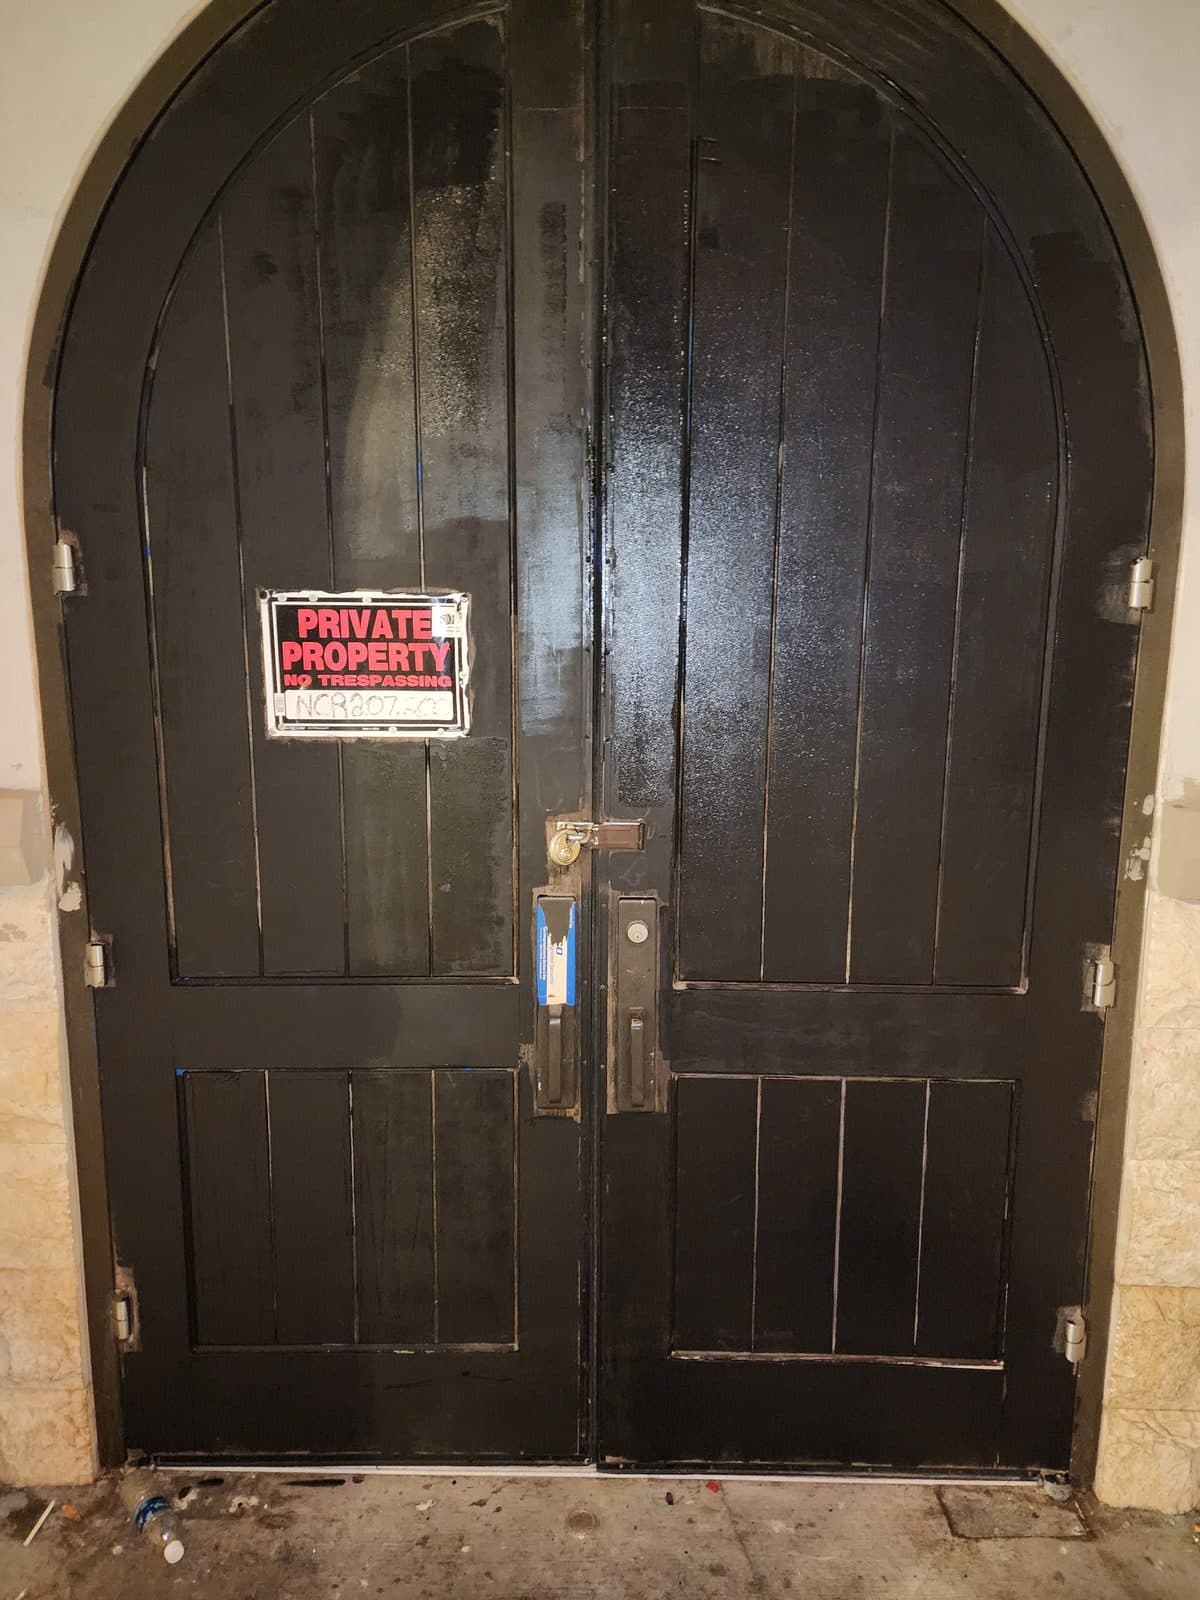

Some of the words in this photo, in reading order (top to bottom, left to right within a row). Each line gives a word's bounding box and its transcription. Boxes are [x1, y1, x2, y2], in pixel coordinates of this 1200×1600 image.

[297, 609, 433, 640] PRIVATE
[281, 641, 450, 672] PROPERTY
[284, 674, 313, 687] NO
[317, 674, 453, 688] TRESPASSING
